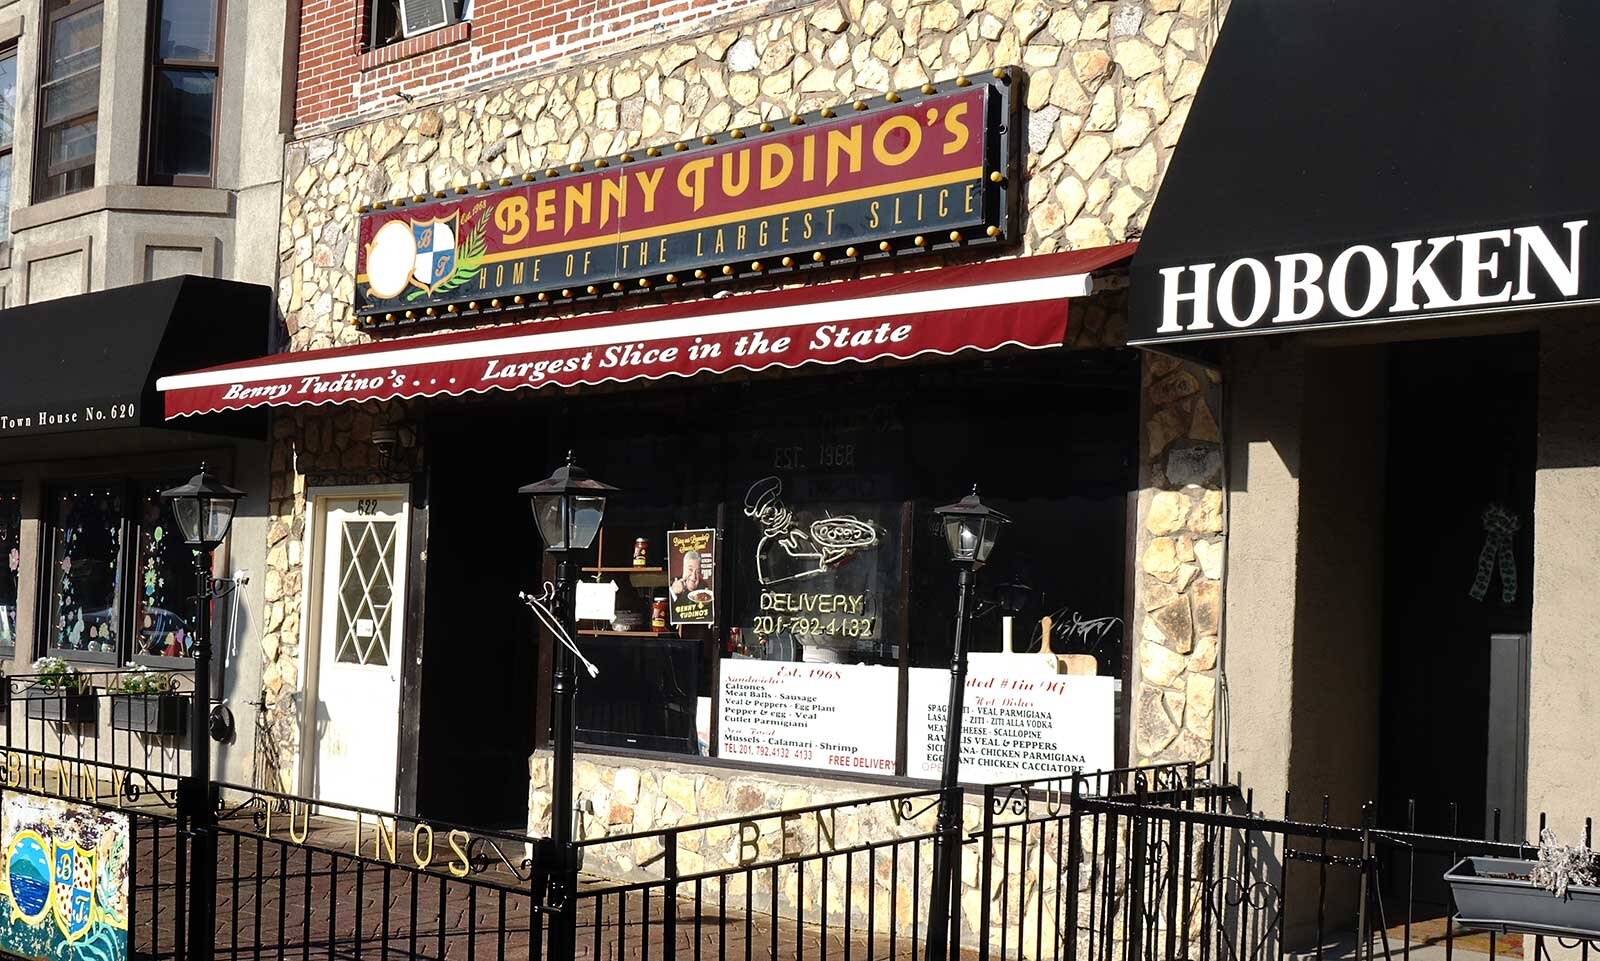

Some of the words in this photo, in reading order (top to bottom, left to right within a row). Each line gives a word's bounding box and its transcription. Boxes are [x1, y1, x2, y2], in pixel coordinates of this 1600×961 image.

[495, 168, 665, 244] BENNY
[677, 102, 970, 213] TUDINO'S
[479, 258, 541, 290] HOME
[565, 251, 591, 278] OF
[622, 238, 668, 269] THE
[696, 209, 836, 257] LARGEST
[870, 184, 975, 229] SLICE
[1156, 219, 1589, 334] HOBOKEN
[222, 382, 293, 400] Benny
[298, 369, 406, 394] Tudino's
[481, 352, 593, 382] Largest
[599, 341, 678, 369] Slice
[688, 337, 722, 362] in
[734, 331, 792, 355] the
[809, 322, 913, 351] State
[0, 415, 32, 429] Town
[38, 411, 78, 426] House
[85, 406, 107, 421] No.
[110, 403, 135, 419] 620
[358, 499, 378, 516] 622
[760, 592, 864, 614] DELIVERY
[808, 669, 843, 680] 1968
[725, 683, 765, 691] Calzones
[750, 691, 772, 699] Balls
[780, 693, 817, 702] Sausage
[725, 707, 757, 716] Pepper
[795, 712, 817, 720] Veal
[754, 700, 788, 709] Peppers
[794, 703, 810, 711] Egg
[812, 703, 836, 713] Plant
[927, 704, 970, 714] SPAGTI
[977, 706, 999, 716] VEAL
[1000, 708, 1052, 720] PARMIGIANA
[724, 715, 751, 723] Cutlet
[1006, 717, 1024, 727] ALLA
[1026, 720, 1053, 729] VODKA
[957, 726, 987, 736] HEESE
[994, 728, 1042, 739] SCALLOPINE
[724, 734, 760, 744] Mussels
[768, 737, 813, 748] Calamari
[819, 742, 858, 754] Shrimp
[724, 743, 737, 754] TEL
[794, 750, 813, 761] 4133
[974, 737, 1001, 747] VEAL
[1013, 740, 1058, 751] PEPPERS
[828, 755, 851, 767] FREE
[853, 757, 896, 771] DELIVERY
[926, 754, 975, 766] EGGANT
[977, 758, 1019, 769] CHICKEN
[980, 747, 1020, 759] CHICKEN
[1023, 751, 1086, 763] PARMIGIANA
[922, 762, 944, 773] OPE
[6, 751, 128, 809] BENNY
